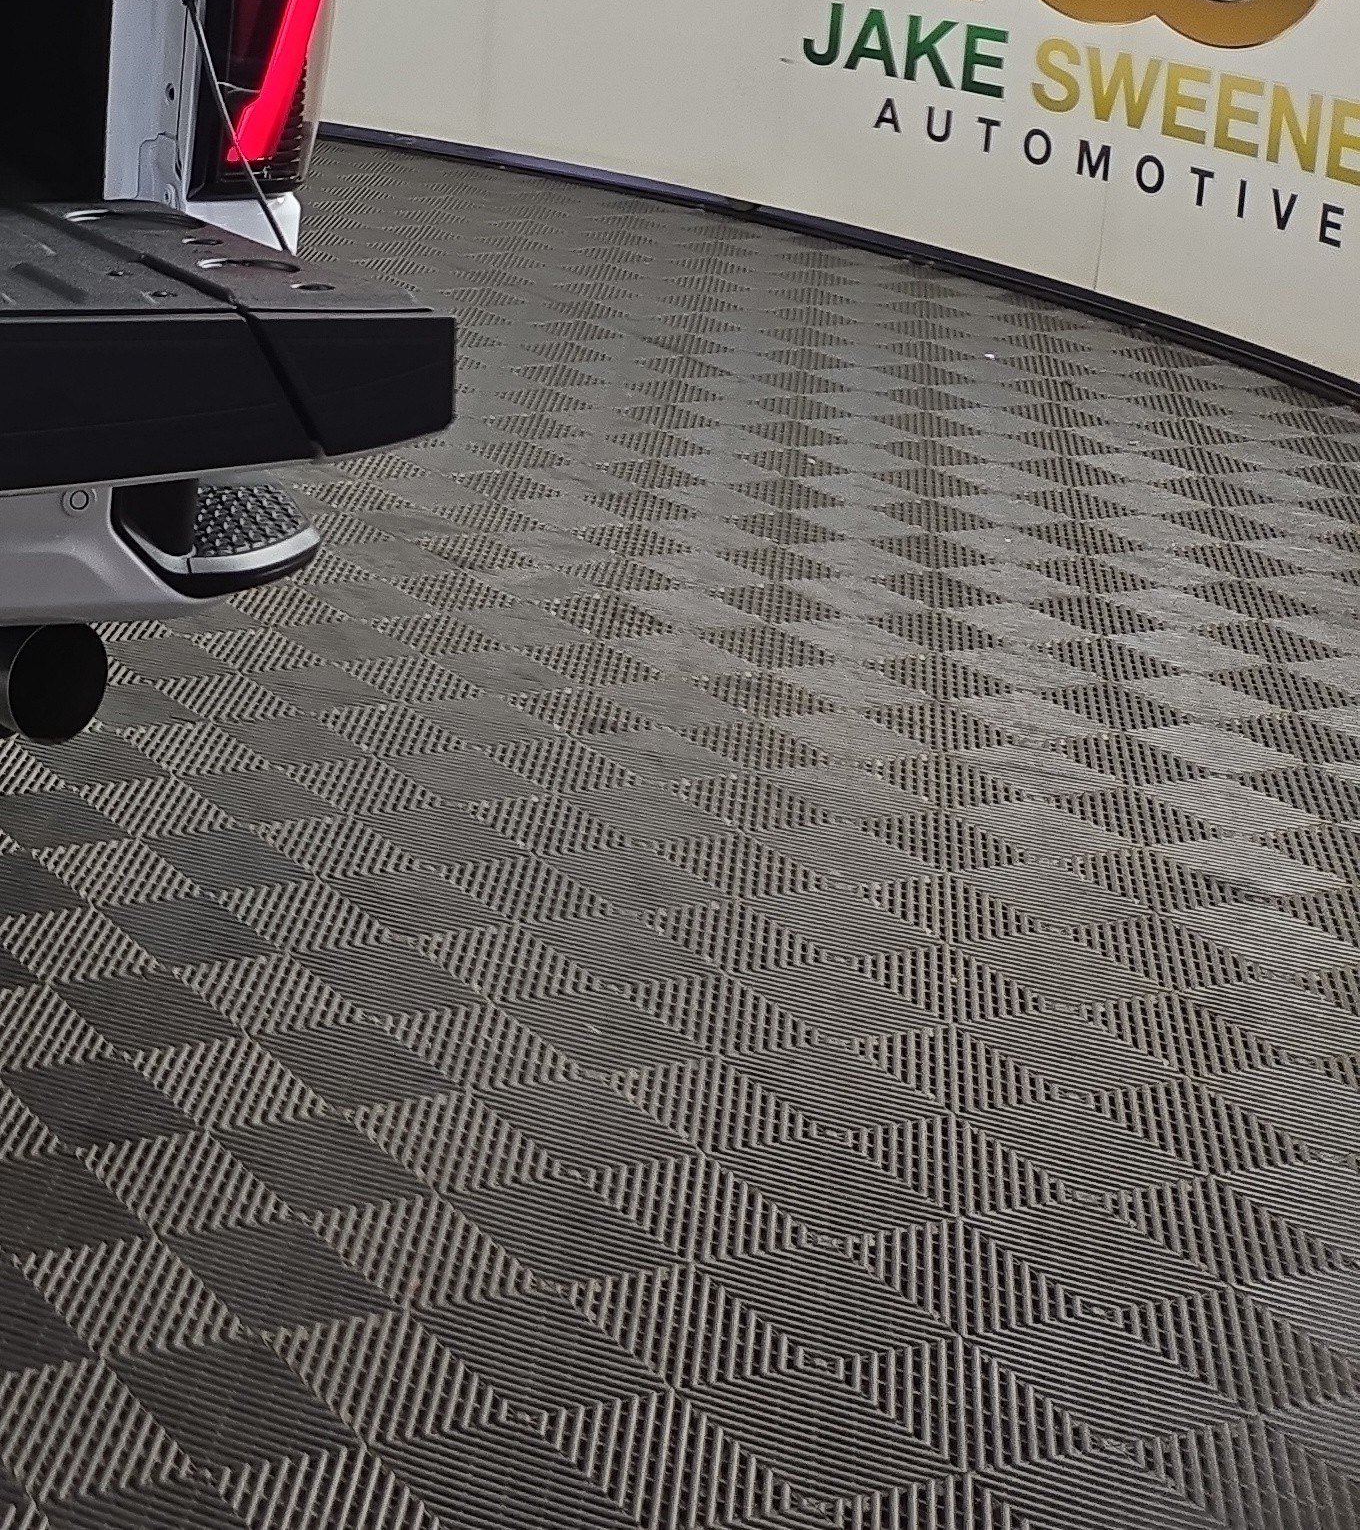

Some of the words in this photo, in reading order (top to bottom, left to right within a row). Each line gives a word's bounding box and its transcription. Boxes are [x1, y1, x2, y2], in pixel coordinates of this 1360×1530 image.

[802, 2, 1009, 100] JAKE
[1031, 38, 1360, 188] SWEENE
[873, 97, 1346, 249] AUTOMOTIVE
